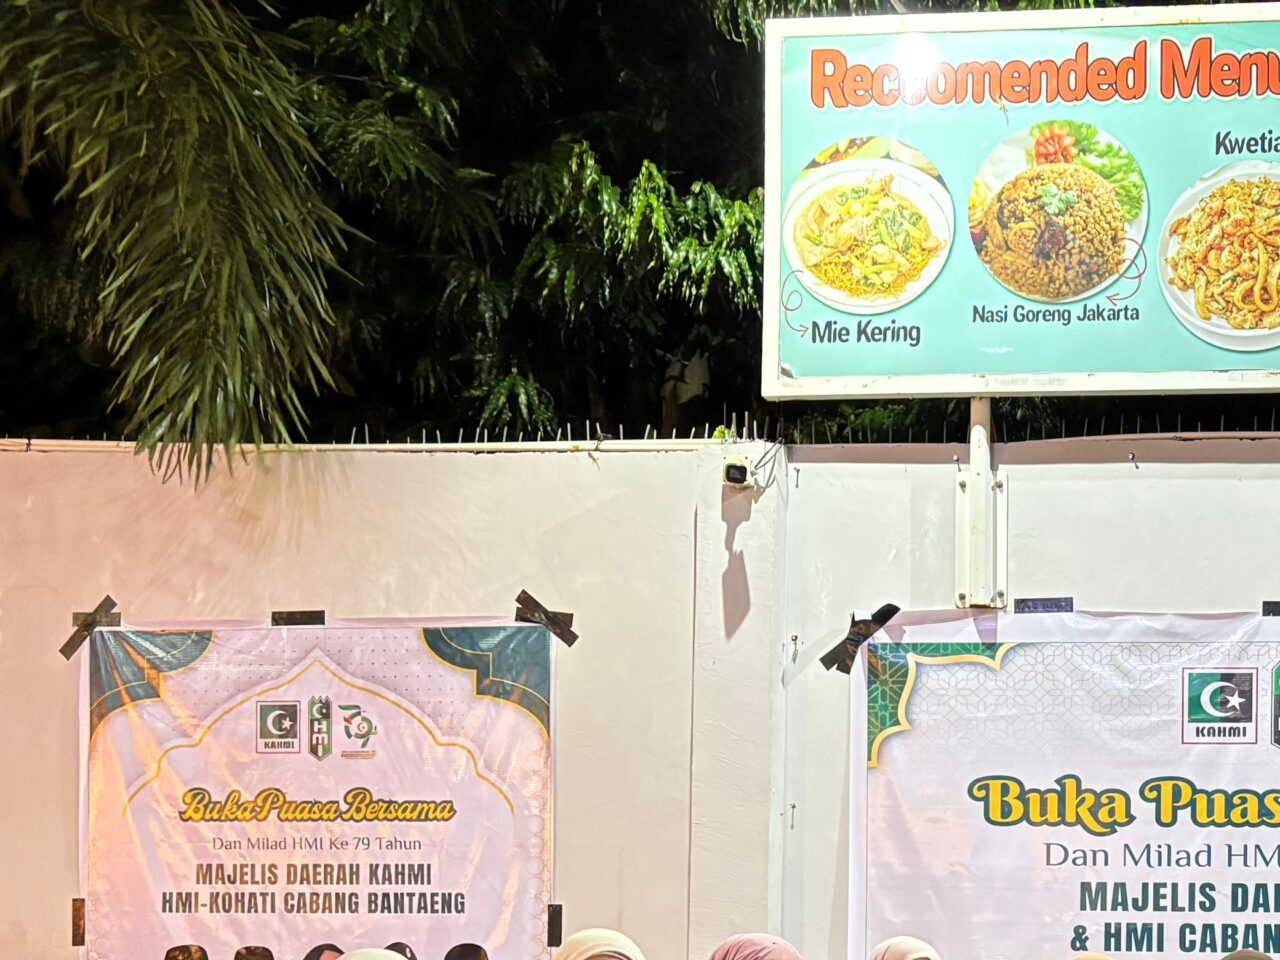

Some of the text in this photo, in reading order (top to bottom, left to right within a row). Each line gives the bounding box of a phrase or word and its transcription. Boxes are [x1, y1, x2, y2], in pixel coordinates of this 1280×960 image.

[972, 302, 1140, 328] Nasi Goreng Jakarta
[811, 319, 922, 347] Mie Kering
[263, 740, 295, 750] KAHMI
[1195, 726, 1247, 738] KAHMI
[179, 787, 457, 822] Buka Puasa Bersama
[967, 774, 1136, 837] Buka
[212, 836, 422, 851] Dan Milad HMI Ke 79 Tahun
[1043, 842, 1109, 867] Dan
[1123, 842, 1212, 869] Milad
[195, 863, 432, 885] MAJELIS DAERAH KAHMI
[161, 891, 466, 914] HMI-KOHATI CABANG BANTAENG
[1079, 881, 1216, 912] MAJELIS
[1070, 924, 1090, 952] &
[1104, 922, 1165, 952] HMI
